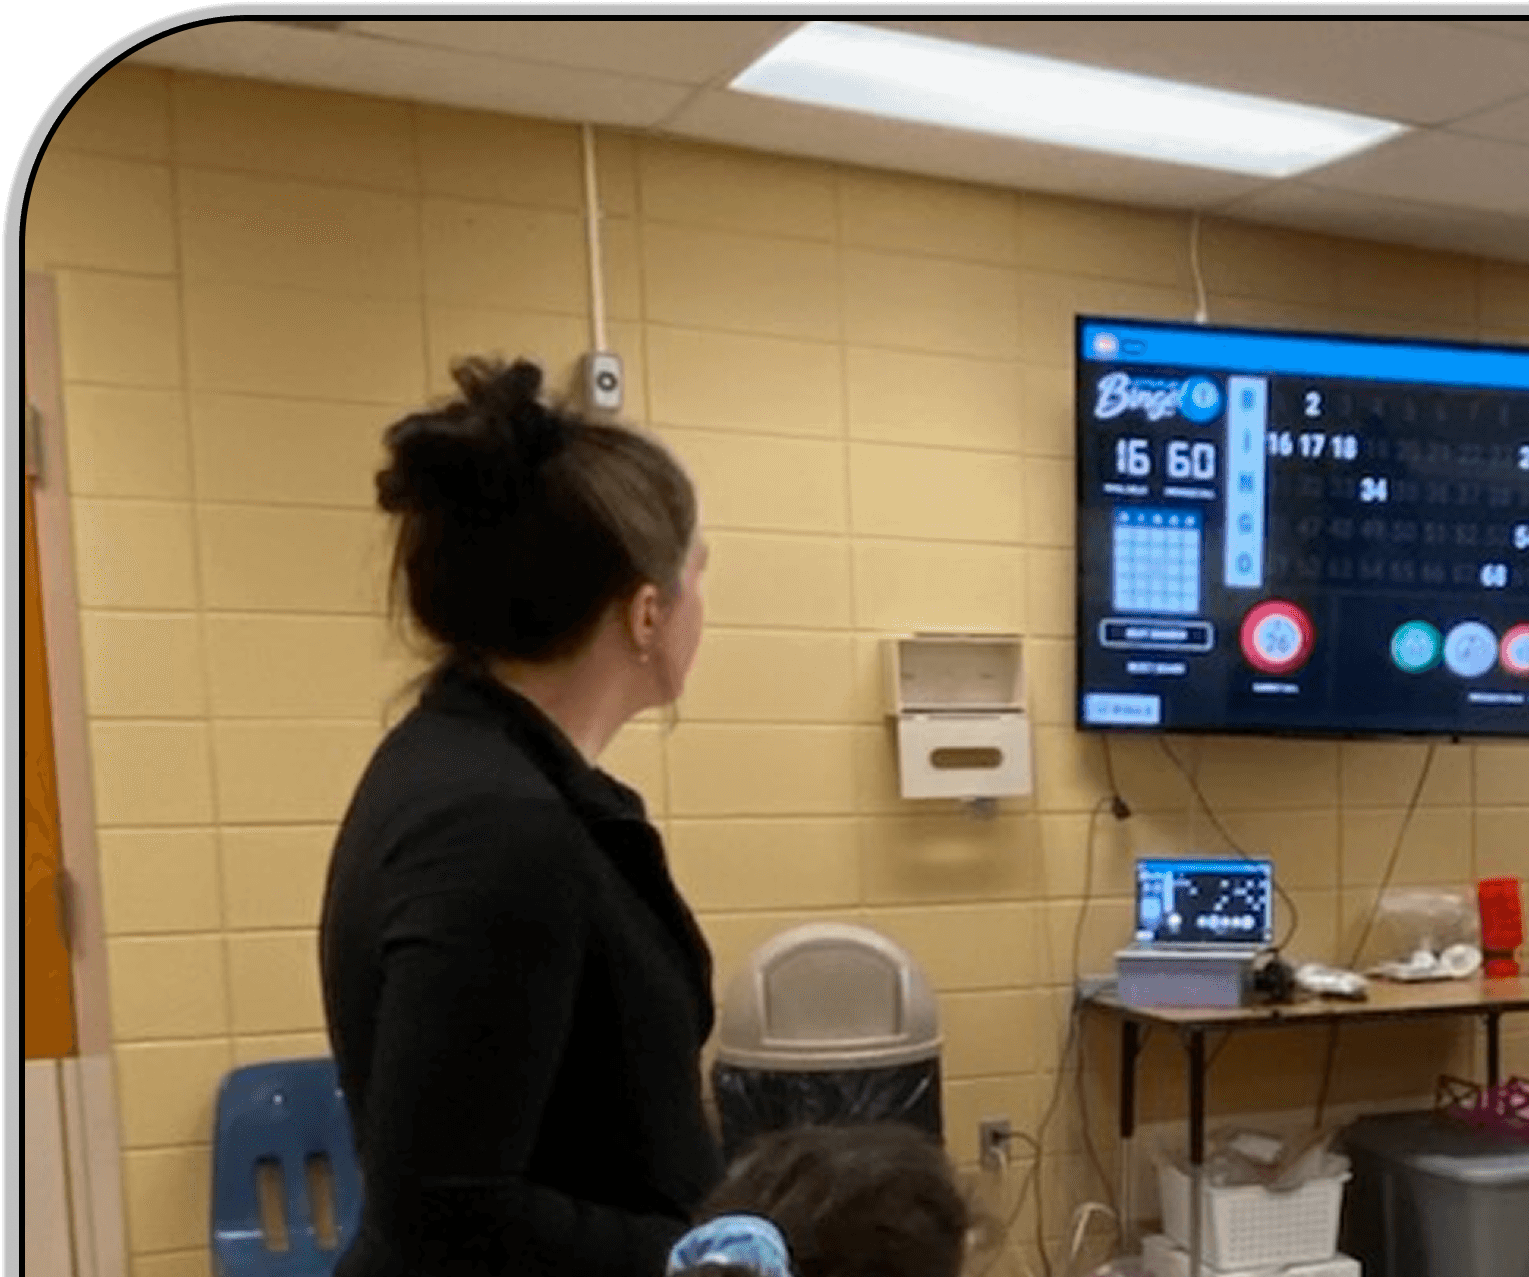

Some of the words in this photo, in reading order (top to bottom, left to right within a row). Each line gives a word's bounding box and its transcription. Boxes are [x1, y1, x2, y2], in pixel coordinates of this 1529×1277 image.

[1304, 391, 1322, 416] 2
[1115, 438, 1150, 475] 16
[1268, 432, 1293, 457] 16
[1299, 433, 1326, 458] 17
[1332, 435, 1357, 460] 18
[1167, 441, 1215, 480] 60
[1360, 477, 1388, 502] 34
